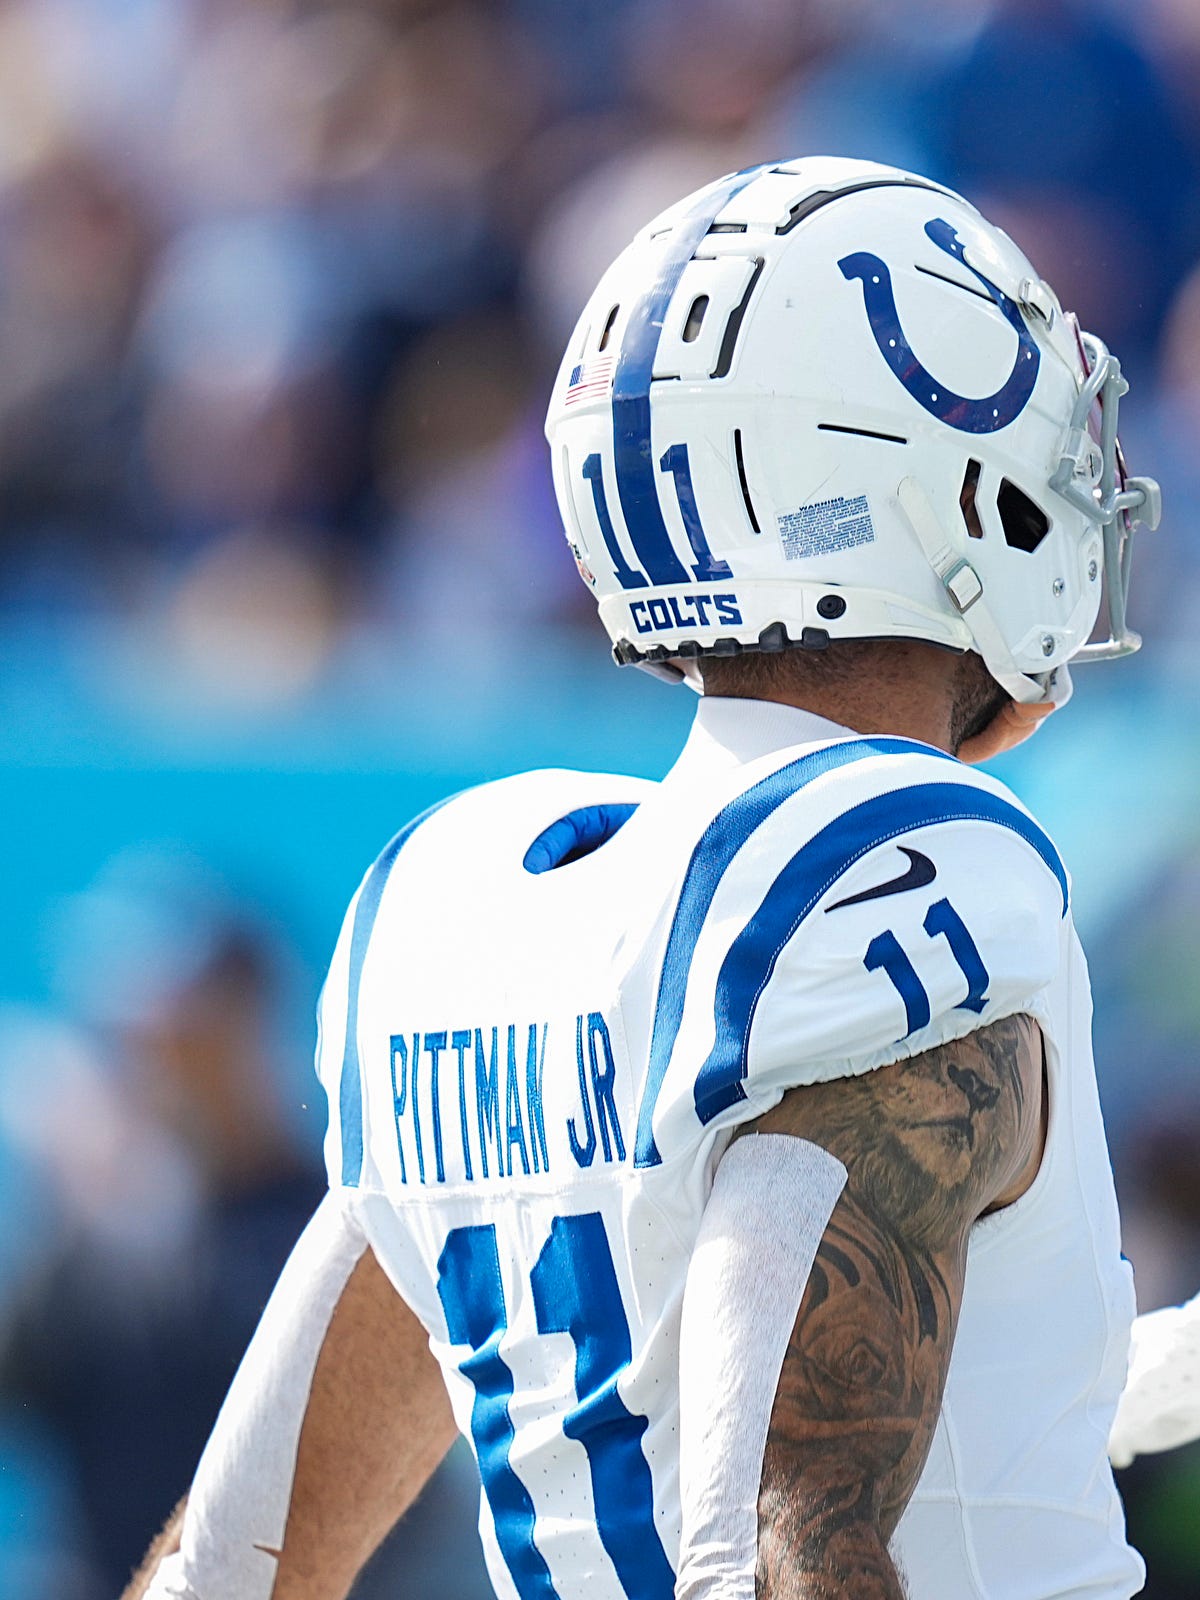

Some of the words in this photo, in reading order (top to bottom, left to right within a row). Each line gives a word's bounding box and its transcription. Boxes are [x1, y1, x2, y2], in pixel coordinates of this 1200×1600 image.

[628, 594, 743, 634] COLTS
[863, 897, 991, 1042] 11
[389, 1021, 550, 1185] PITTMAN
[565, 1011, 627, 1169] JR
[436, 1212, 678, 1600] 11
